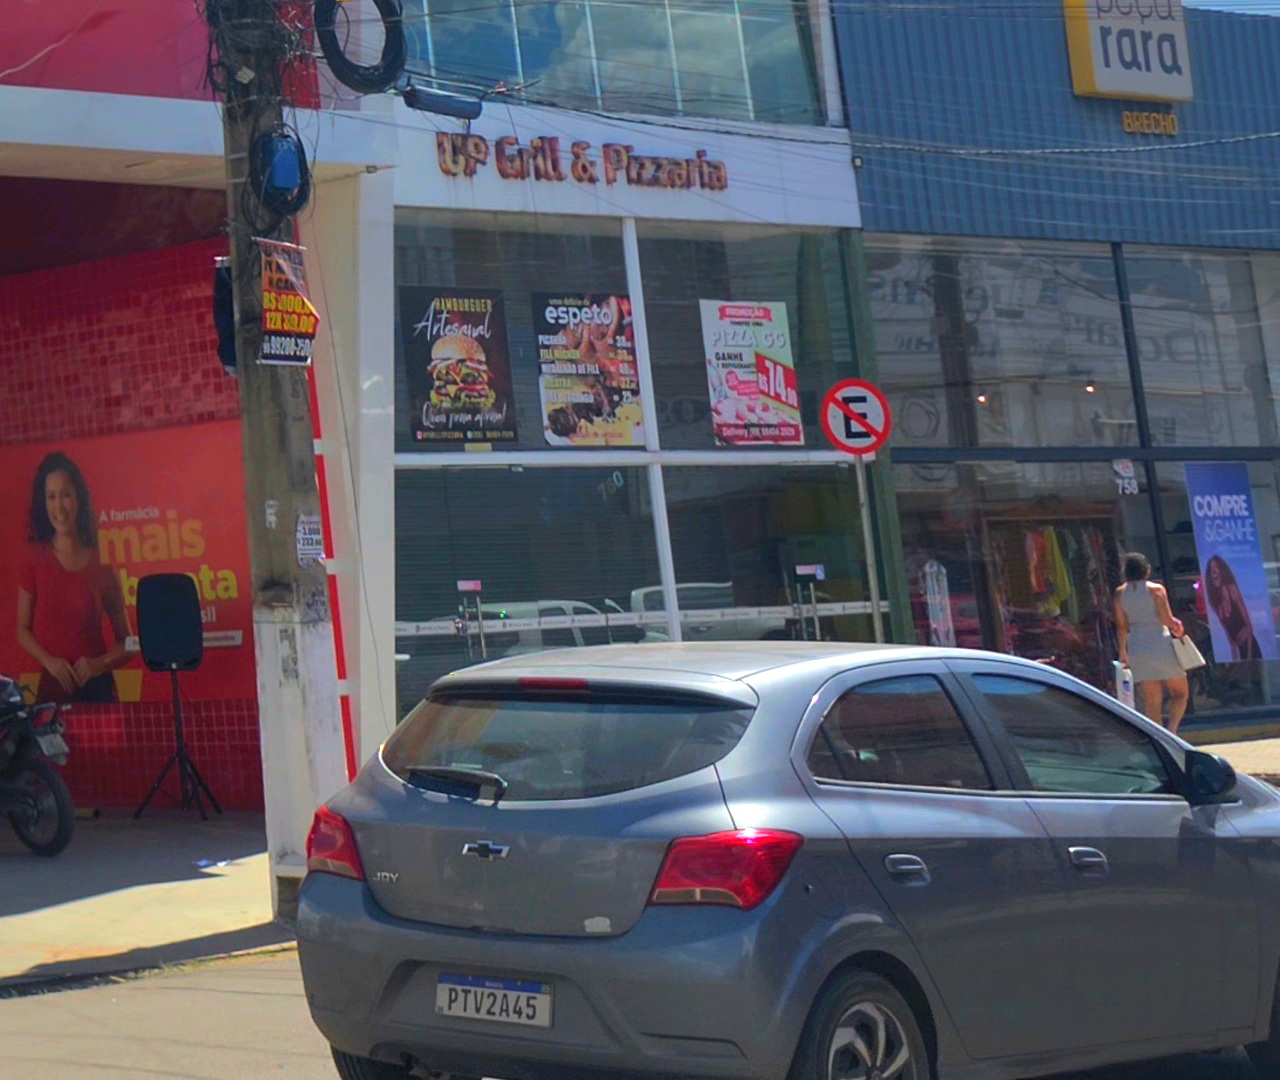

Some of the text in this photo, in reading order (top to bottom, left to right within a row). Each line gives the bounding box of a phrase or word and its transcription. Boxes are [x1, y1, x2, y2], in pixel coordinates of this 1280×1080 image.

[1098, 23, 1184, 76] rara
[435, 131, 728, 190] UP Grill & Pizzaria
[545, 303, 613, 330] espeto
[713, 328, 759, 349] PIZZA
[715, 352, 744, 362] GANHE
[841, 395, 872, 440] E
[1115, 478, 1139, 496] 758
[99, 506, 160, 522] A farmácia
[1193, 494, 1250, 517] COMPRE
[97, 508, 206, 566] mais
[372, 870, 399, 883] JOY
[445, 985, 539, 1022] PTV2A45
